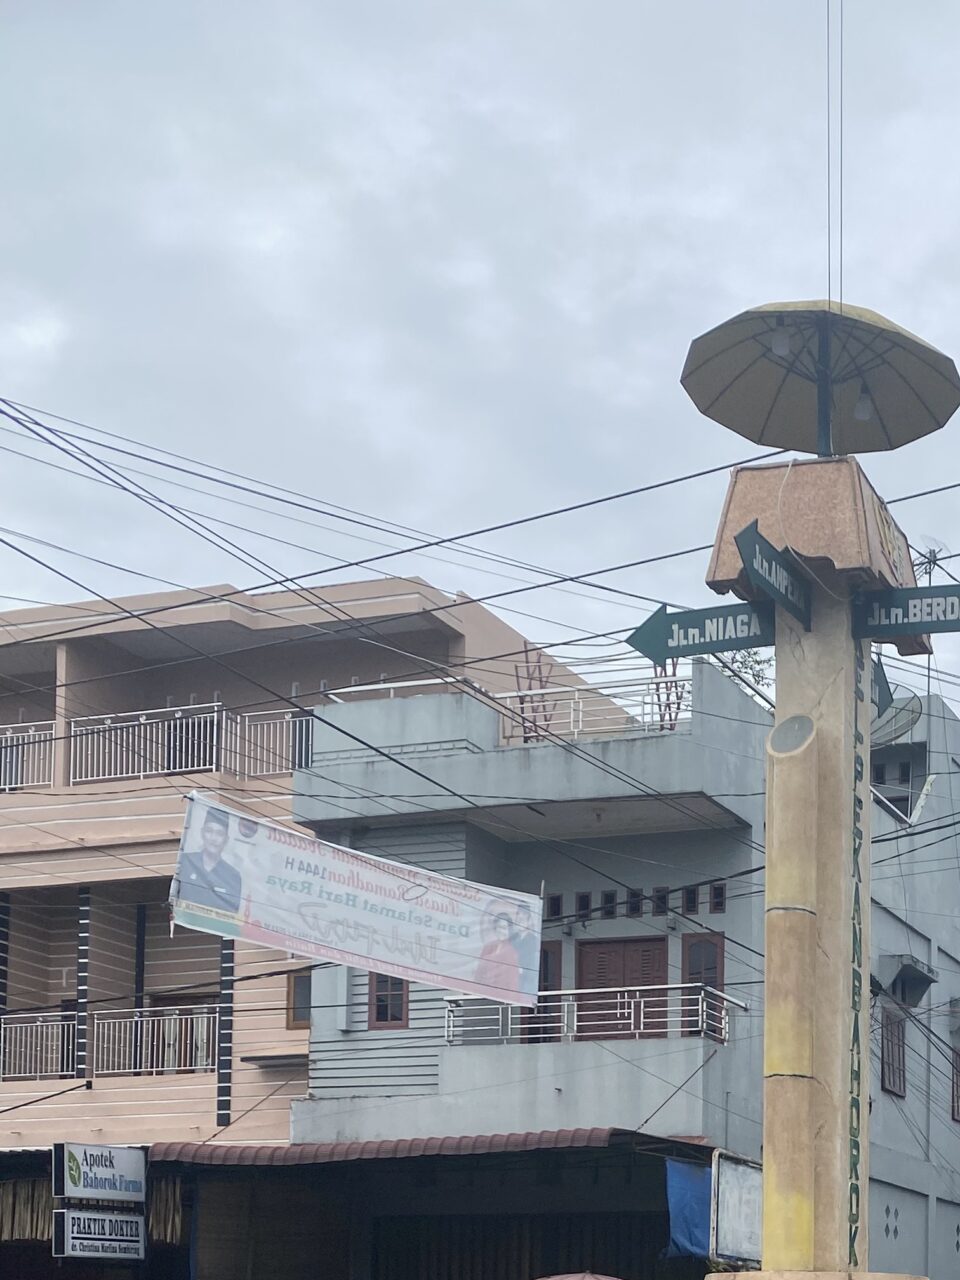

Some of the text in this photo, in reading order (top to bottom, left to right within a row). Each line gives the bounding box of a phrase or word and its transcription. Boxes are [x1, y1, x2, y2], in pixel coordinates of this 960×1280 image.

[81, 1148, 115, 1172] Apotek
[71, 1217, 140, 1237] PRAKTIK DOKTER
